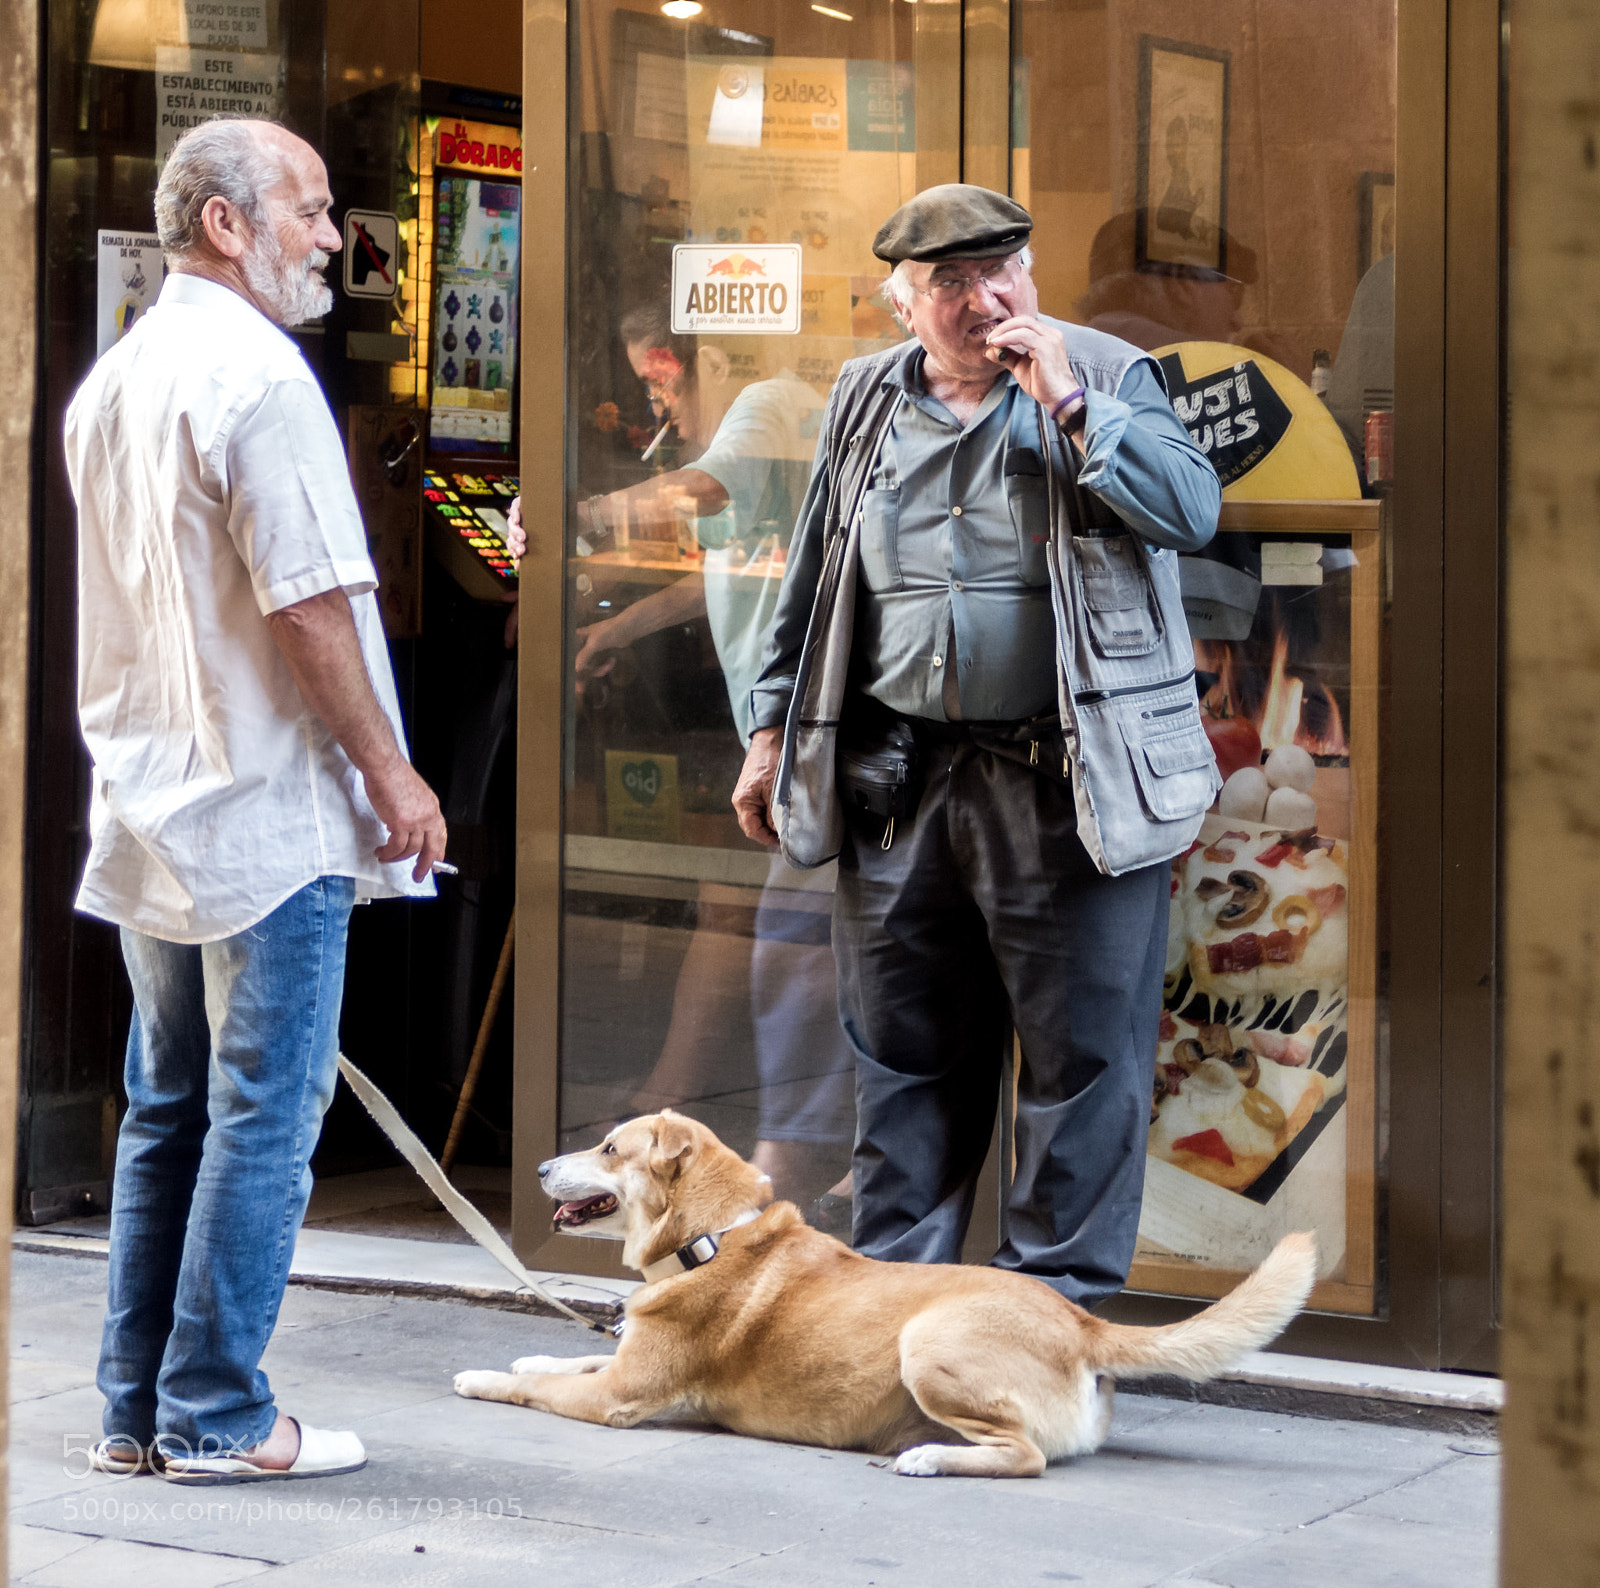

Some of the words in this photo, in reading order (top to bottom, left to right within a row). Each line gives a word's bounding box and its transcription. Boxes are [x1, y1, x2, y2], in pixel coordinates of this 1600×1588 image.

[227, 5, 238, 17] DE
[241, 7, 260, 18] ESTE
[190, 18, 216, 30] LOCAL
[219, 20, 229, 31] ES
[232, 21, 243, 32] DE
[205, 59, 233, 73] ESTE
[162, 75, 273, 95] ESTABLECIMIENTO
[167, 92, 196, 109] ESTÁ
[200, 97, 252, 113] ABIERTO
[255, 101, 269, 114] AL
[162, 111, 211, 128] PÚBLIC
[455, 123, 467, 139] EL
[440, 132, 522, 171] DORADO
[126, 238, 132, 246] LA
[120, 248, 127, 257] DE
[685, 283, 787, 314] ABIERTO
[1173, 361, 1251, 424] UJi
[1189, 408, 1260, 454] UES
